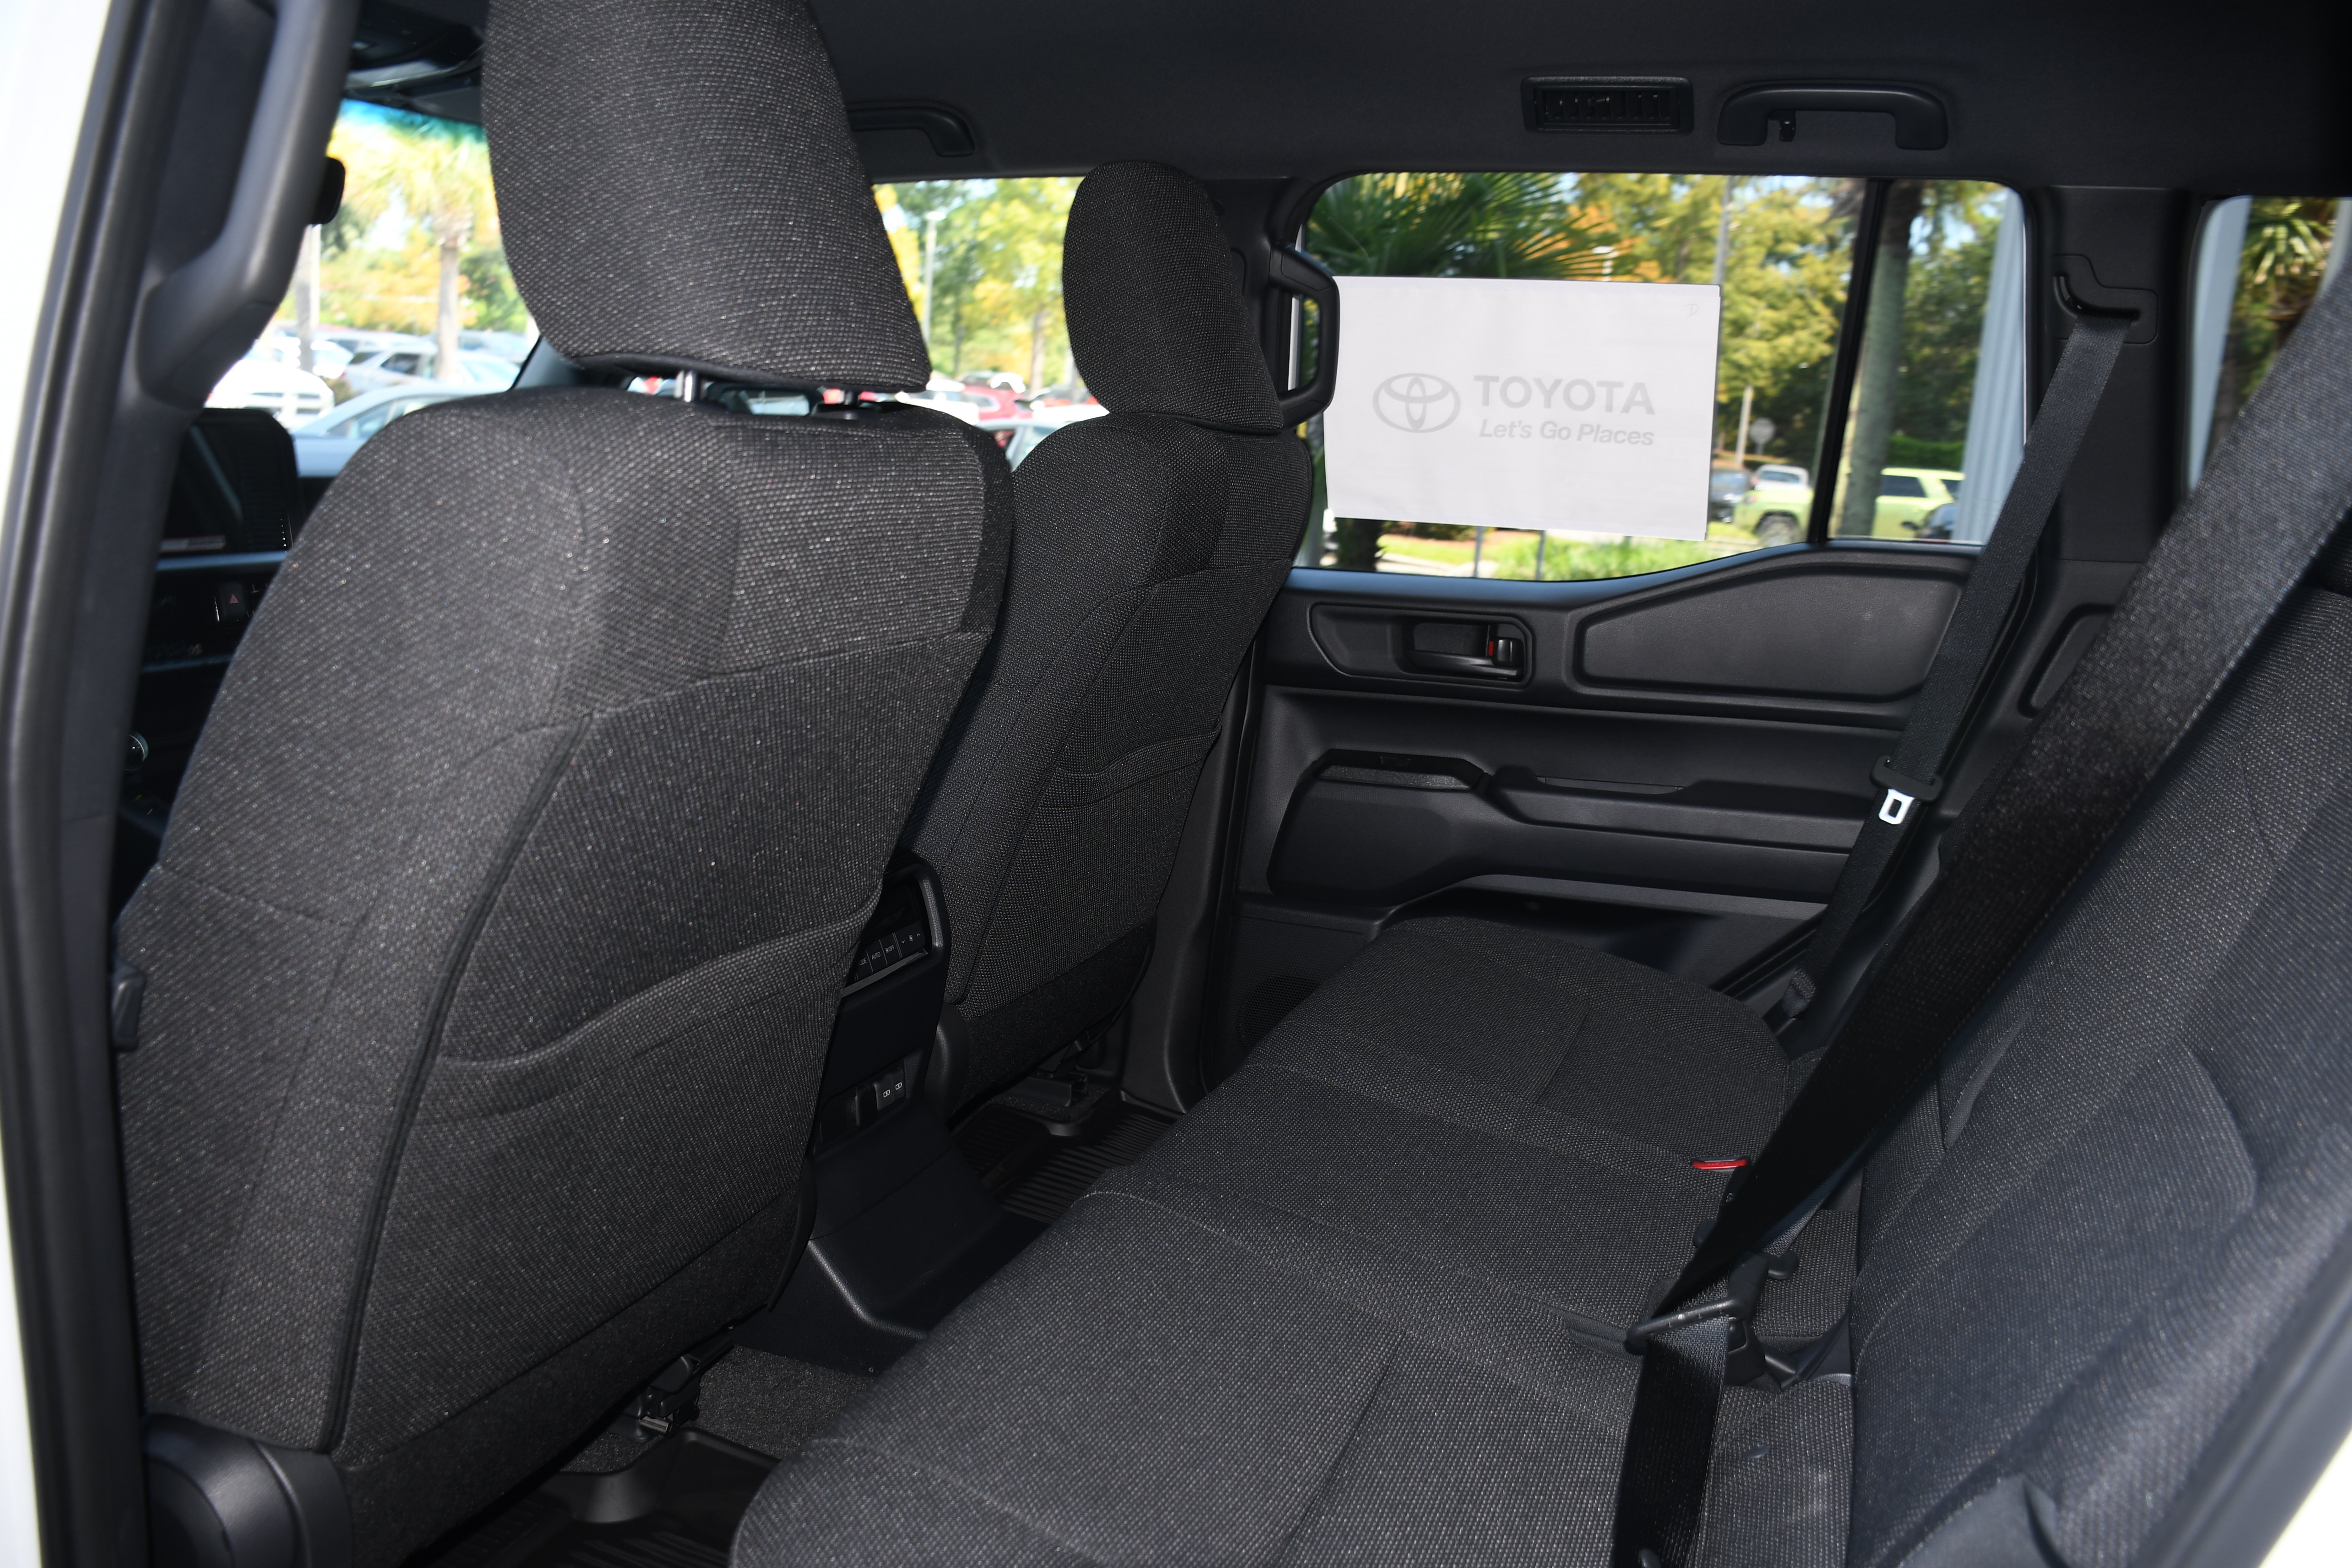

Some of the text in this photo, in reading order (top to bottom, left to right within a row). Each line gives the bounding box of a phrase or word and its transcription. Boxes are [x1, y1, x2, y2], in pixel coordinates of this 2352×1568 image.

[1473, 375, 1655, 415] TOYOTA
[1479, 419, 1655, 446] Let's Go Places
[871, 952, 881, 960] AUTO
